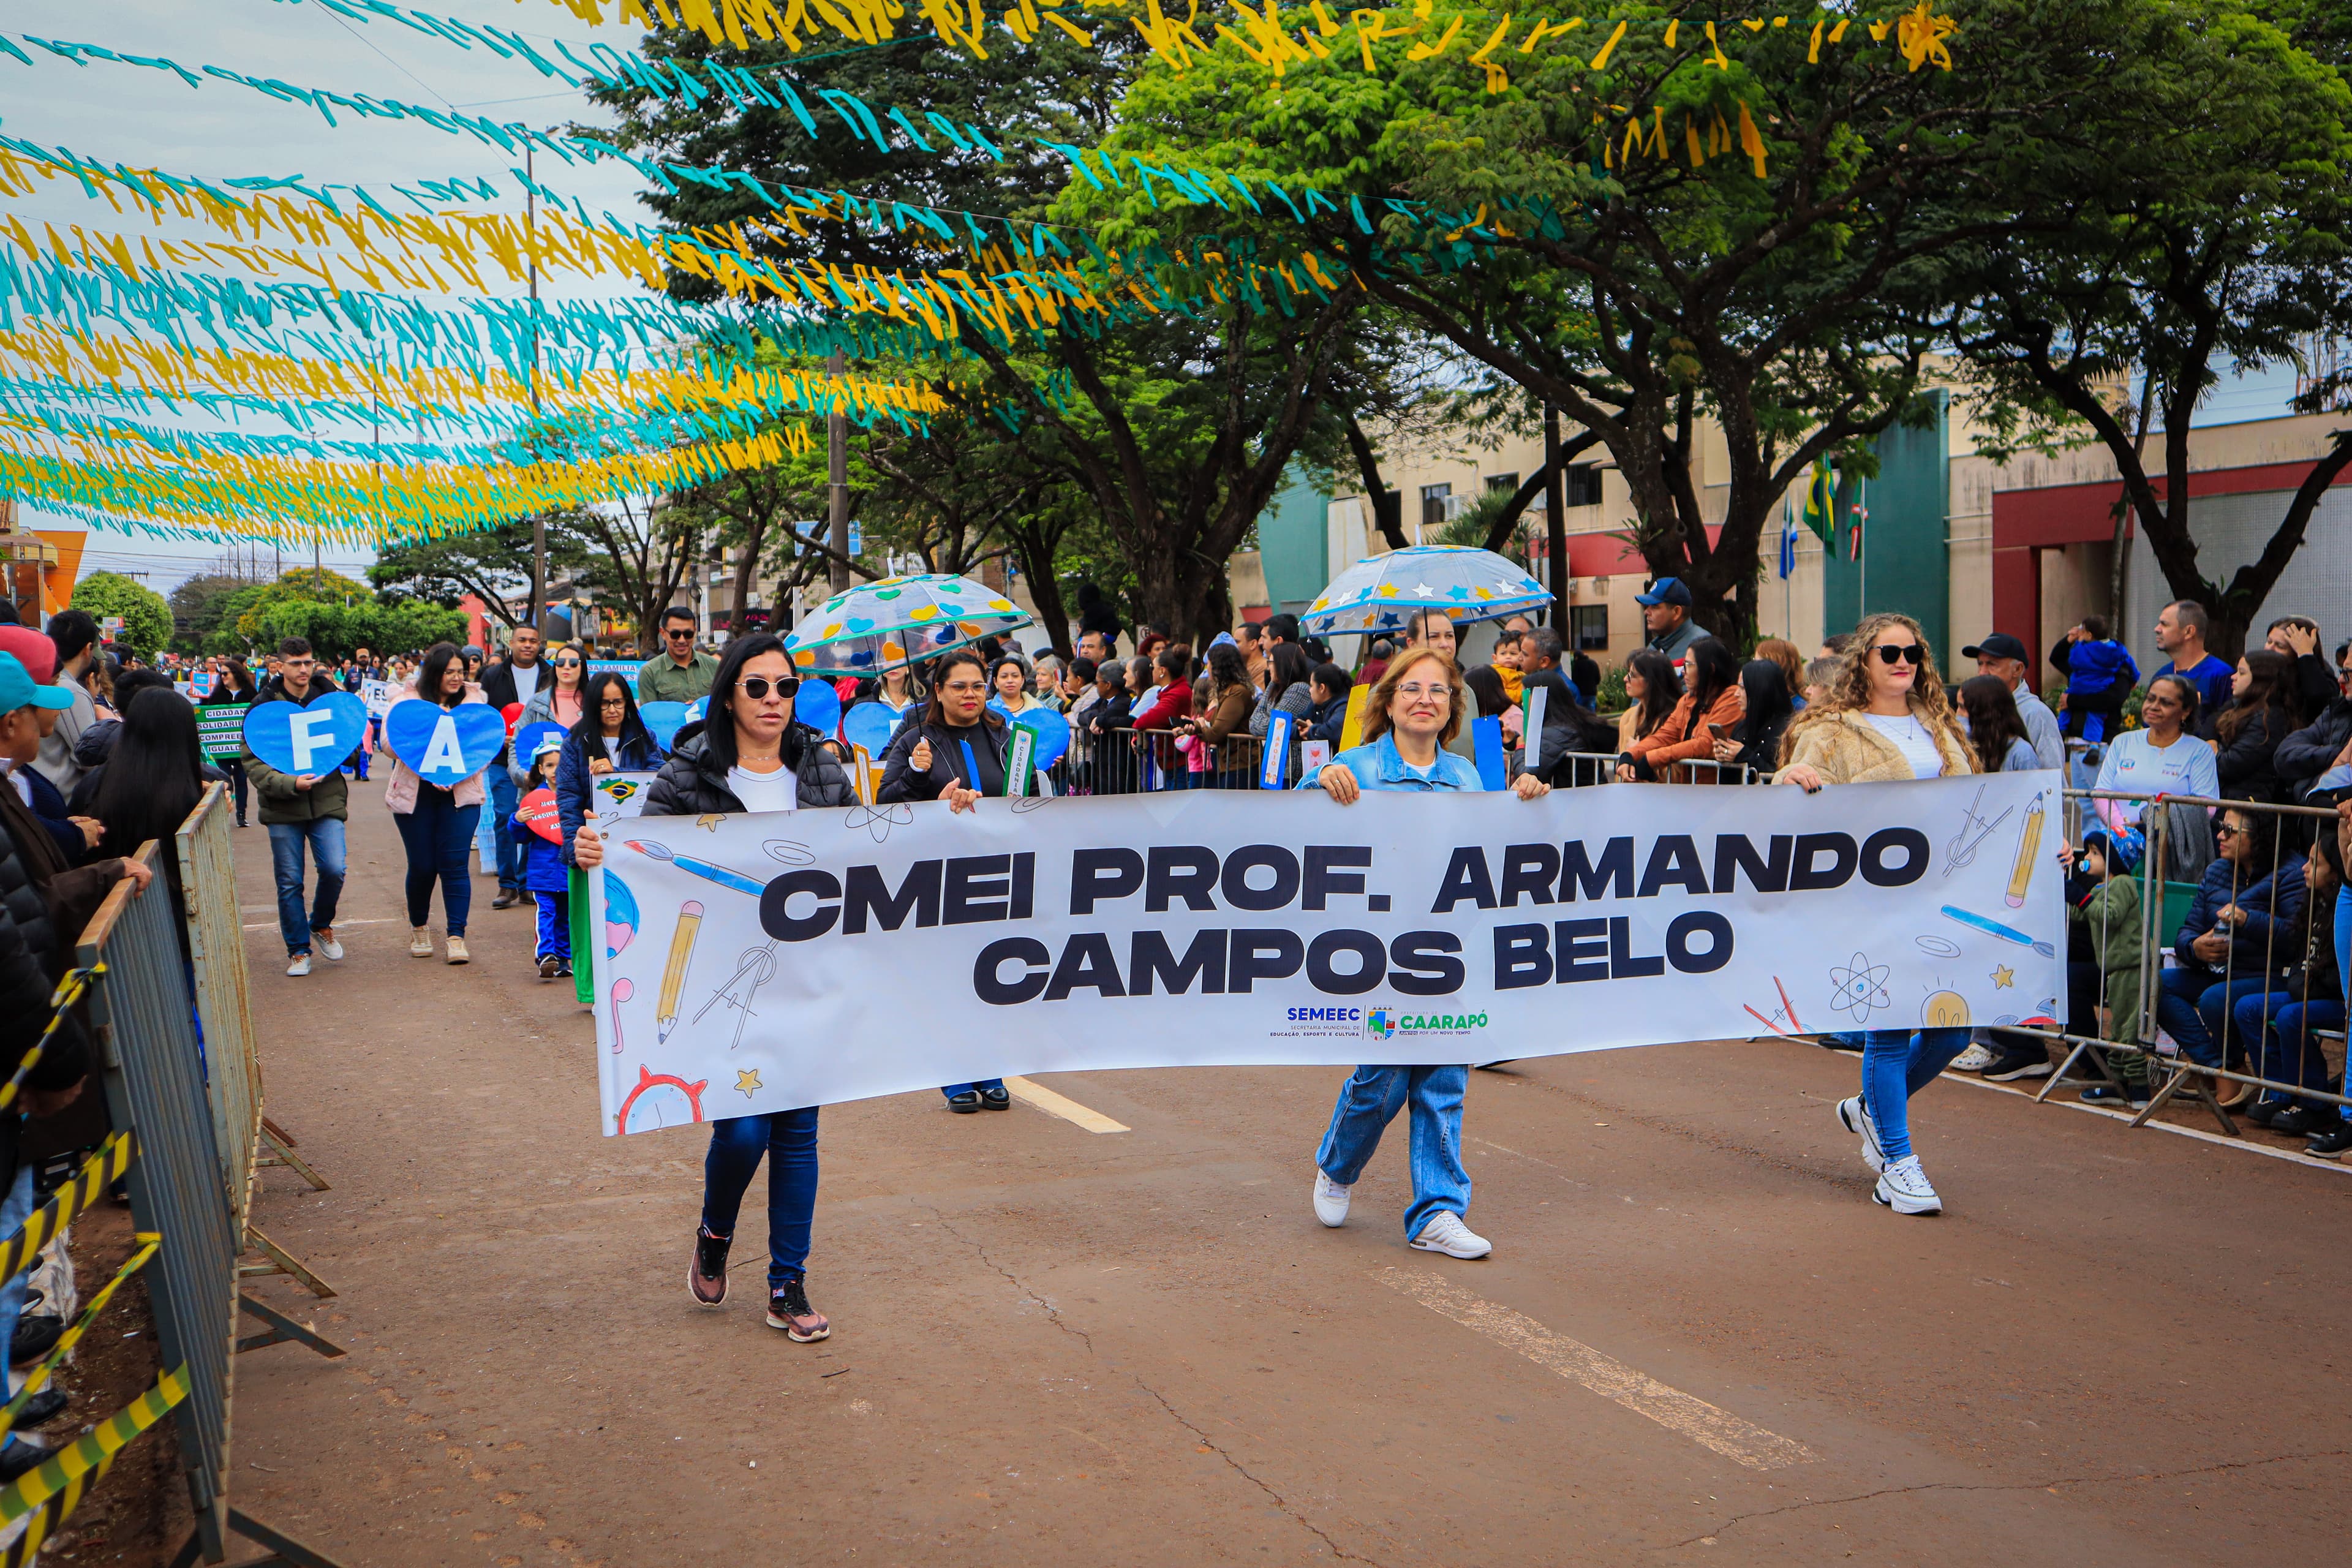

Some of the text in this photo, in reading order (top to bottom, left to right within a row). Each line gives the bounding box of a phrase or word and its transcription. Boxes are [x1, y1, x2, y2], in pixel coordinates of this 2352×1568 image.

[289, 709, 334, 771] F
[419, 715, 466, 774] A
[760, 827, 1930, 942] CMEI PROF. ARMANDO
[974, 911, 1734, 1005] CAMPOS BELO
[1287, 1008, 1360, 1021] SEMEEC
[1400, 1009, 1488, 1030] CAARAPÓ
